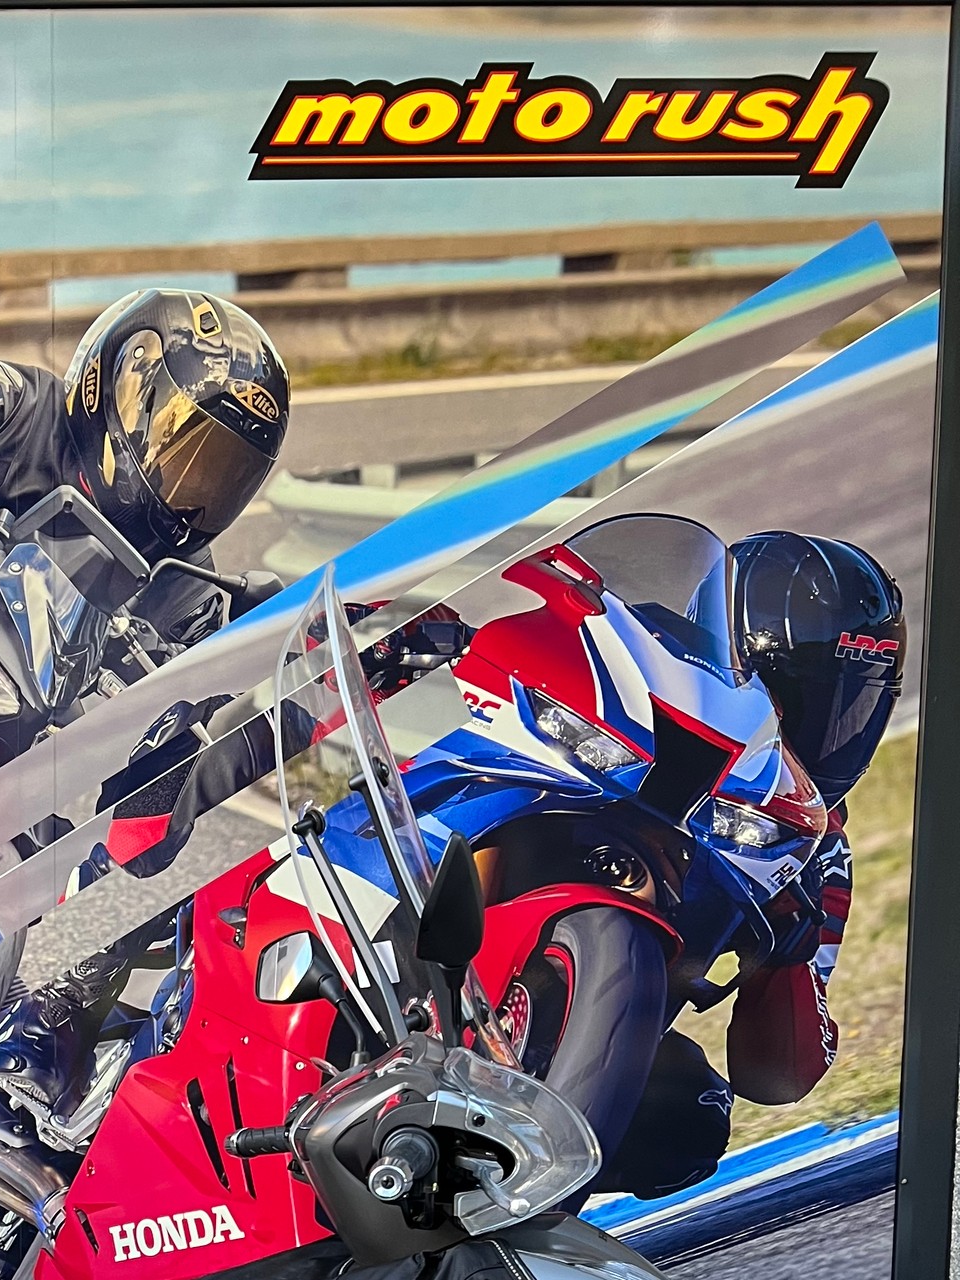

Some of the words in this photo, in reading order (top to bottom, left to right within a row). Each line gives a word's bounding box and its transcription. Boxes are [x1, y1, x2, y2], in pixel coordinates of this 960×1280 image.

[269, 70, 593, 145] moto
[600, 67, 873, 174] rush
[236, 381, 278, 420] X-lite
[683, 652, 726, 682] HONDA
[835, 631, 900, 667] HRC
[462, 690, 502, 724] RC
[108, 1204, 246, 1263] HONDA
